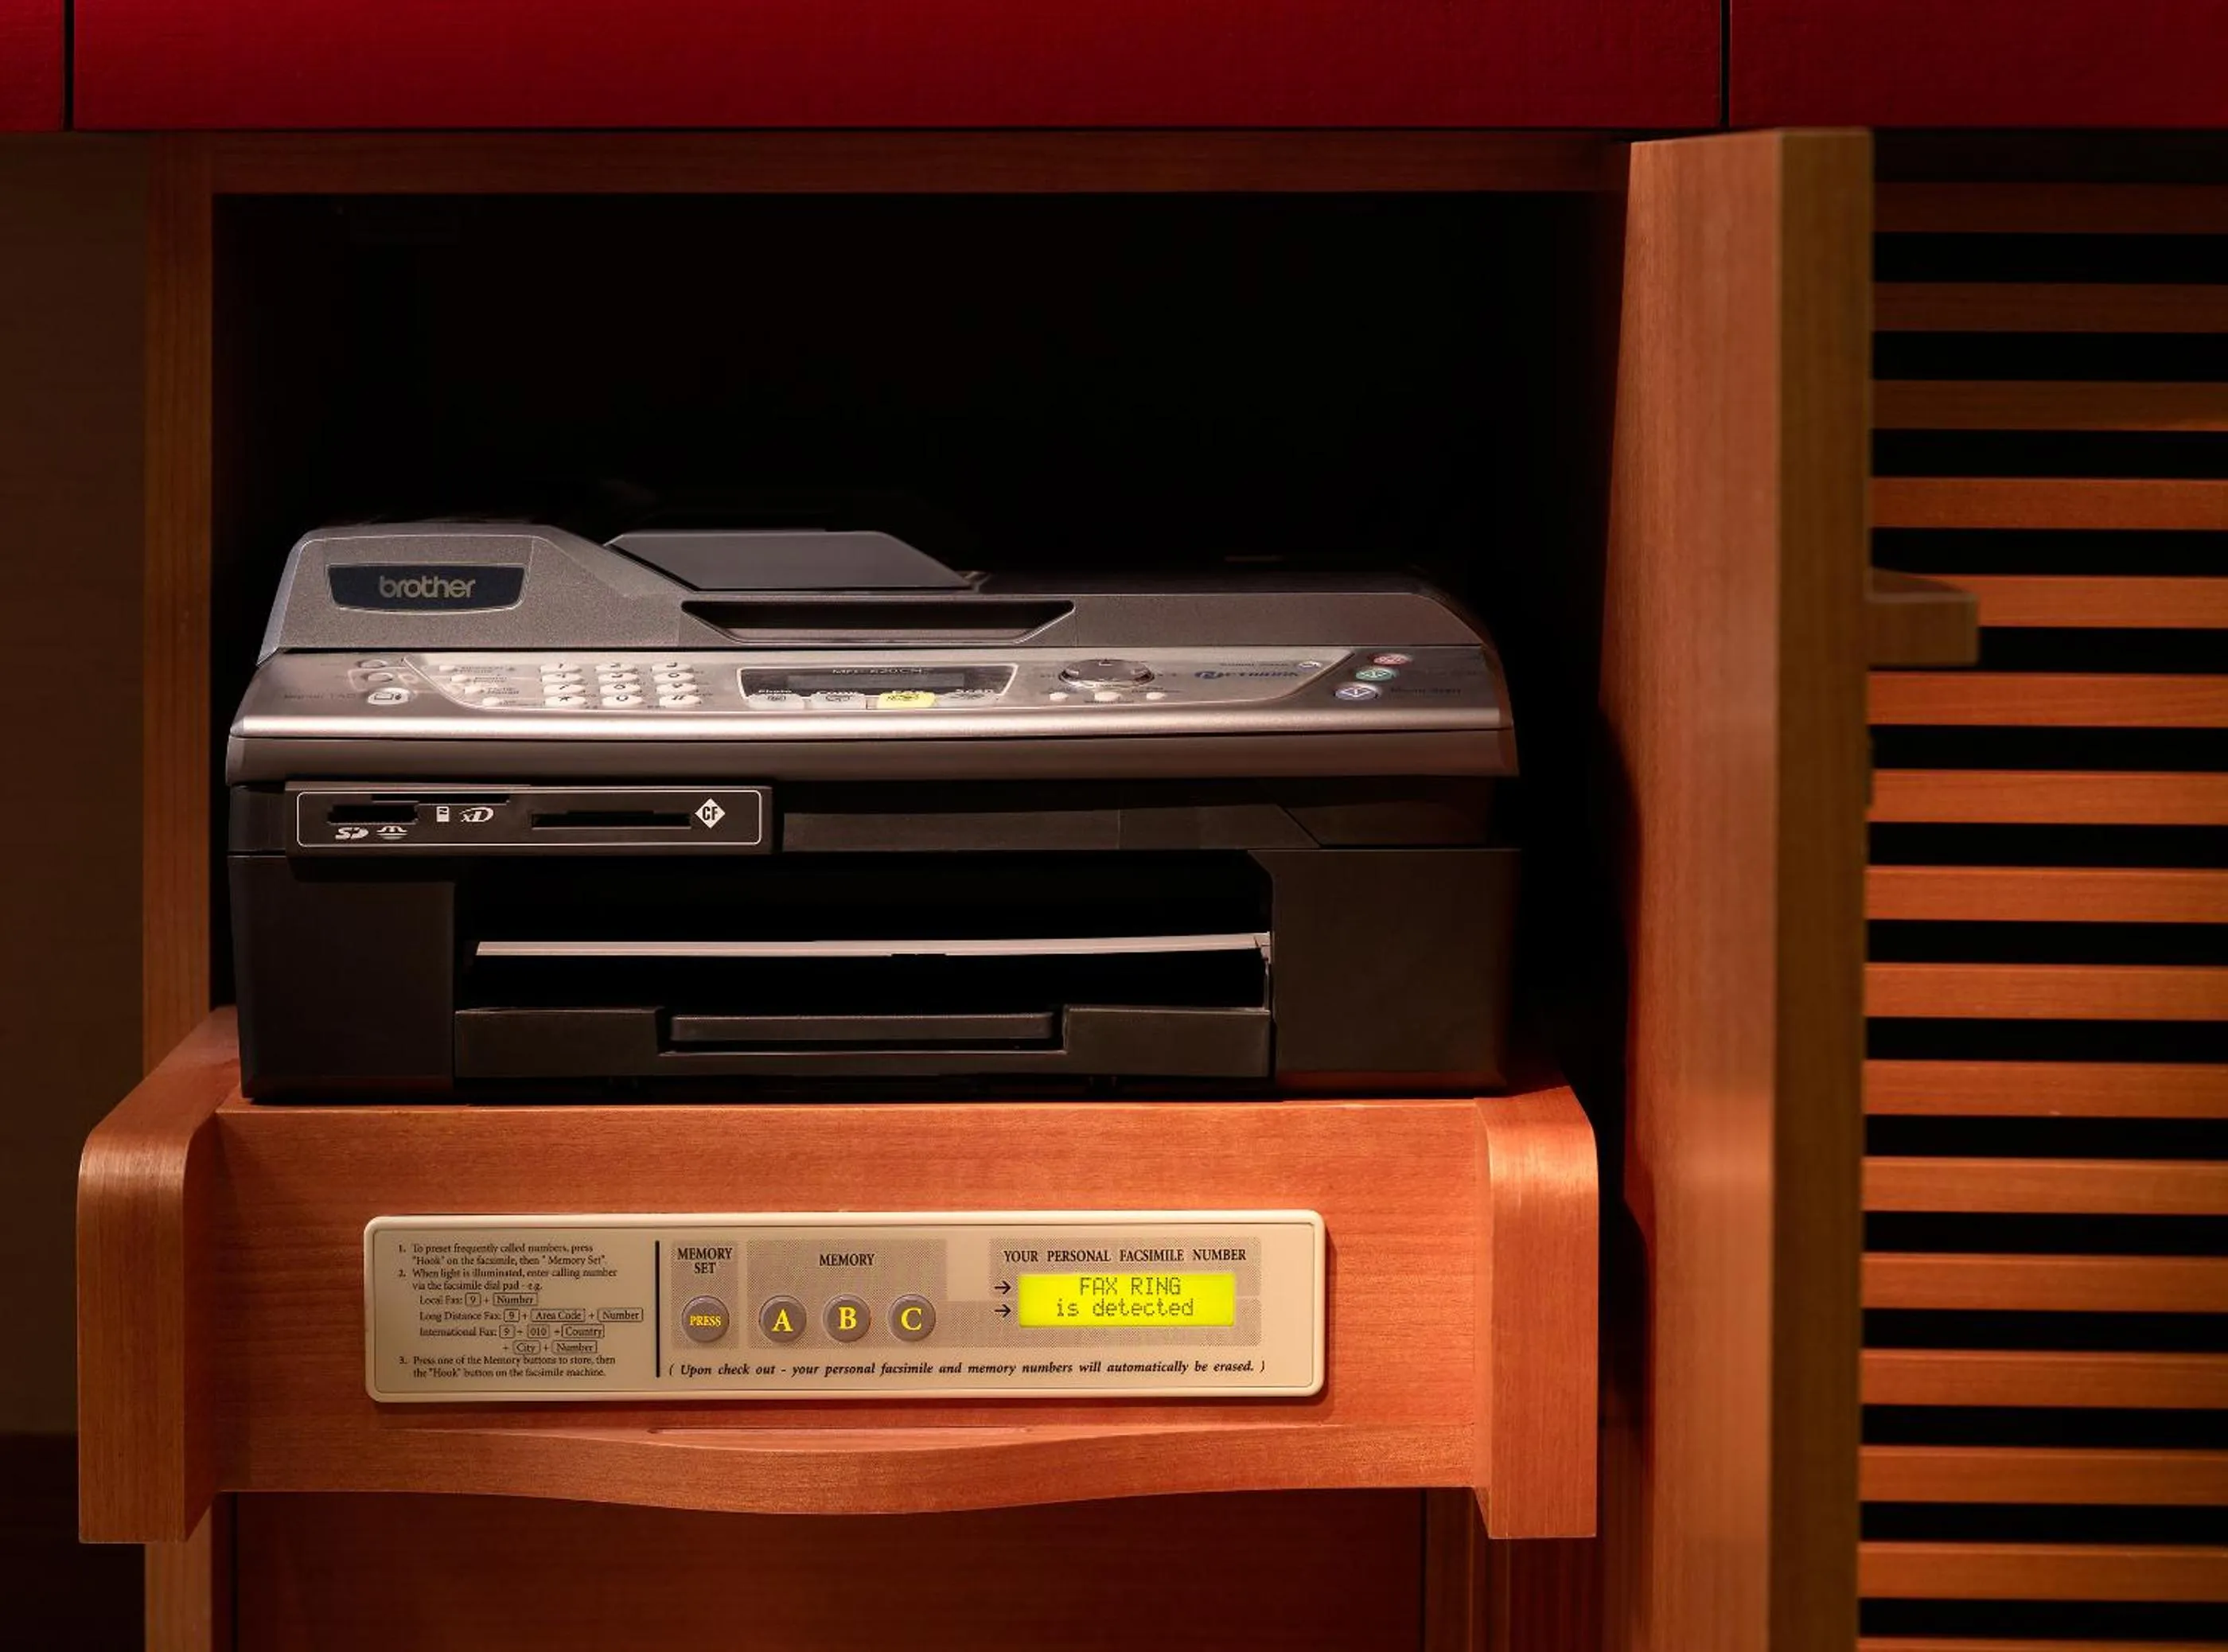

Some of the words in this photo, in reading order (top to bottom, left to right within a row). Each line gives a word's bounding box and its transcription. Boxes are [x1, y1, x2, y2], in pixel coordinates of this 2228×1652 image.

[379, 575, 476, 598] brother
[702, 806, 718, 820] CF
[399, 1244, 407, 1253] 1.
[414, 1244, 424, 1253] To
[426, 1245, 451, 1255] preset
[454, 1243, 498, 1255] frequently
[500, 1243, 526, 1253] called
[571, 1245, 594, 1255] press
[676, 1247, 733, 1260] MEMORY
[461, 1256, 475, 1265] the
[520, 1255, 540, 1265] then
[819, 1253, 875, 1267] MEMORY
[1003, 1249, 1038, 1264] YOUR
[1046, 1249, 1111, 1263] PERSONAL
[1119, 1249, 1185, 1262] FACSIMILE
[1193, 1248, 1247, 1261] NUMBER
[412, 1268, 438, 1278] When
[441, 1268, 461, 1280] light
[463, 1268, 471, 1278] is
[527, 1269, 549, 1278] enter
[551, 1268, 580, 1280] calling
[582, 1268, 617, 1277] number
[693, 1261, 716, 1274] SET
[412, 1281, 426, 1291] via
[427, 1280, 442, 1291] the
[443, 1280, 482, 1291] facsimile
[484, 1280, 500, 1291] dial
[503, 1280, 520, 1292] pad
[1079, 1276, 1119, 1295] FAX
[1131, 1276, 1181, 1295] RING
[420, 1295, 443, 1305] Local
[497, 1295, 535, 1304] Number
[1057, 1299, 1080, 1317] is
[1092, 1298, 1194, 1317] detected
[419, 1311, 442, 1323] Long
[443, 1311, 482, 1321] Distance
[535, 1311, 556, 1320] Area
[558, 1311, 582, 1320] Code
[602, 1310, 640, 1320] Number
[689, 1314, 722, 1327] PRESS
[771, 1308, 794, 1333] A
[839, 1307, 857, 1331] B
[900, 1307, 923, 1331] C
[419, 1327, 477, 1337] International
[529, 1327, 547, 1337] 010
[565, 1326, 602, 1338] Country
[516, 1342, 536, 1353] City
[556, 1342, 594, 1352] Number
[413, 1356, 436, 1365] Press
[455, 1355, 465, 1365] of
[467, 1355, 482, 1365] the
[483, 1355, 520, 1367] Memory
[524, 1355, 557, 1365] buttons
[559, 1356, 568, 1365] to
[596, 1354, 616, 1365] then
[413, 1368, 427, 1378] the
[463, 1368, 494, 1378] button
[509, 1367, 524, 1377] the
[525, 1367, 564, 1377] facsimile
[680, 1364, 712, 1377] Upon
[718, 1363, 750, 1375] check
[755, 1365, 776, 1375] out
[791, 1366, 820, 1377] your
[824, 1362, 876, 1377] personal
[879, 1362, 933, 1377] facsimile
[938, 1362, 962, 1373] and
[968, 1364, 1017, 1377] memory
[1022, 1361, 1073, 1373] numbers
[1079, 1361, 1101, 1373] will
[1107, 1360, 1189, 1375] automatically
[1194, 1360, 1209, 1373] be
[1213, 1360, 1255, 1373] erased.
